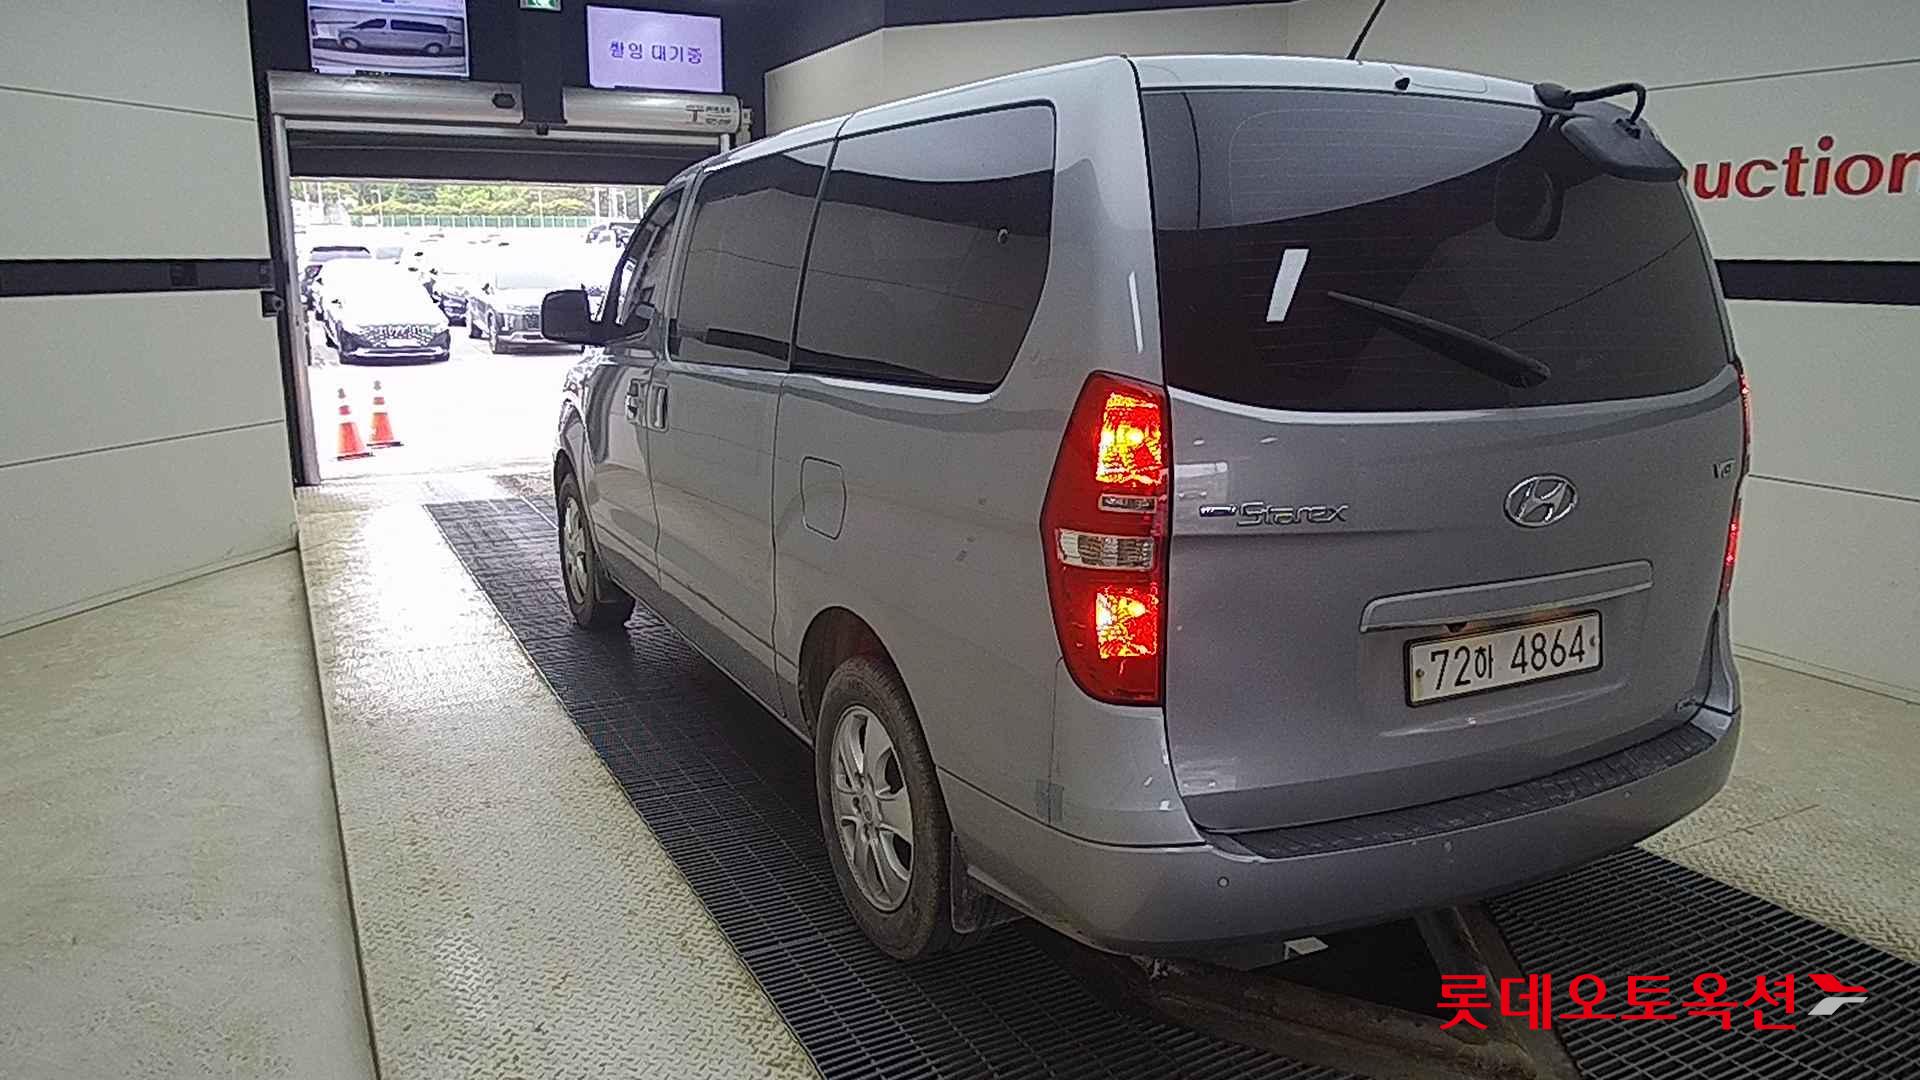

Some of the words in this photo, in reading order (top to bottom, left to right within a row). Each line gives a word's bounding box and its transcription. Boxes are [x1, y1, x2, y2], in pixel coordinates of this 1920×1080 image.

[651, 44, 703, 65] 대기중
[1692, 135, 1920, 200] uction
[1236, 501, 1349, 526] Starex
[1430, 644, 1494, 690] 72하
[1510, 624, 1586, 674] 4864
